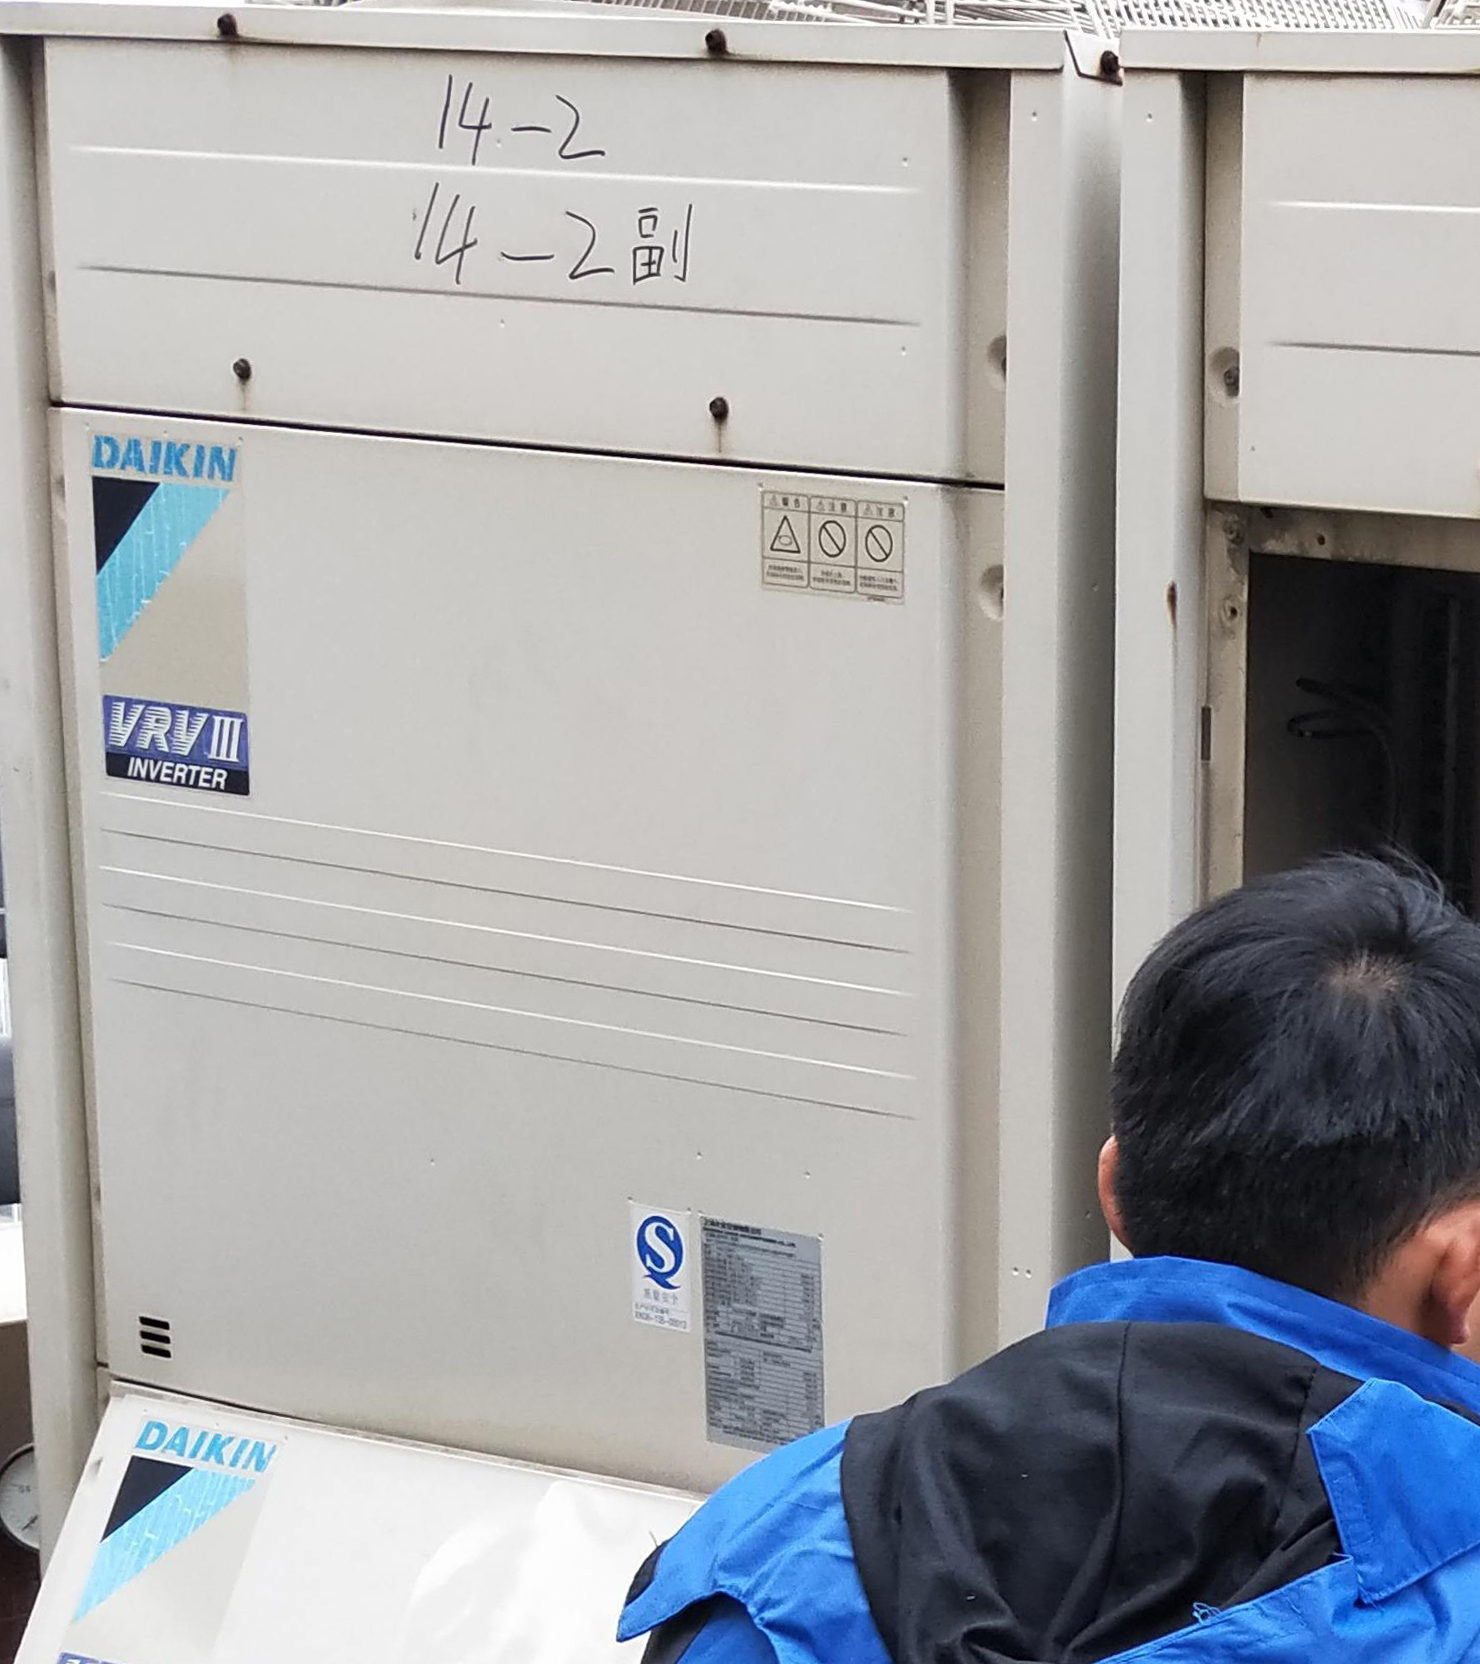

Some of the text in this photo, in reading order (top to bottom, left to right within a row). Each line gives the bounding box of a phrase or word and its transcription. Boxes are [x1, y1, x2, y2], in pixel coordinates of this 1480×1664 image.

[438, 74, 606, 166] 14-2
[92, 434, 238, 482] DAIKIN
[127, 756, 228, 790] INVERTER
[134, 1419, 278, 1474] DAIKIN
